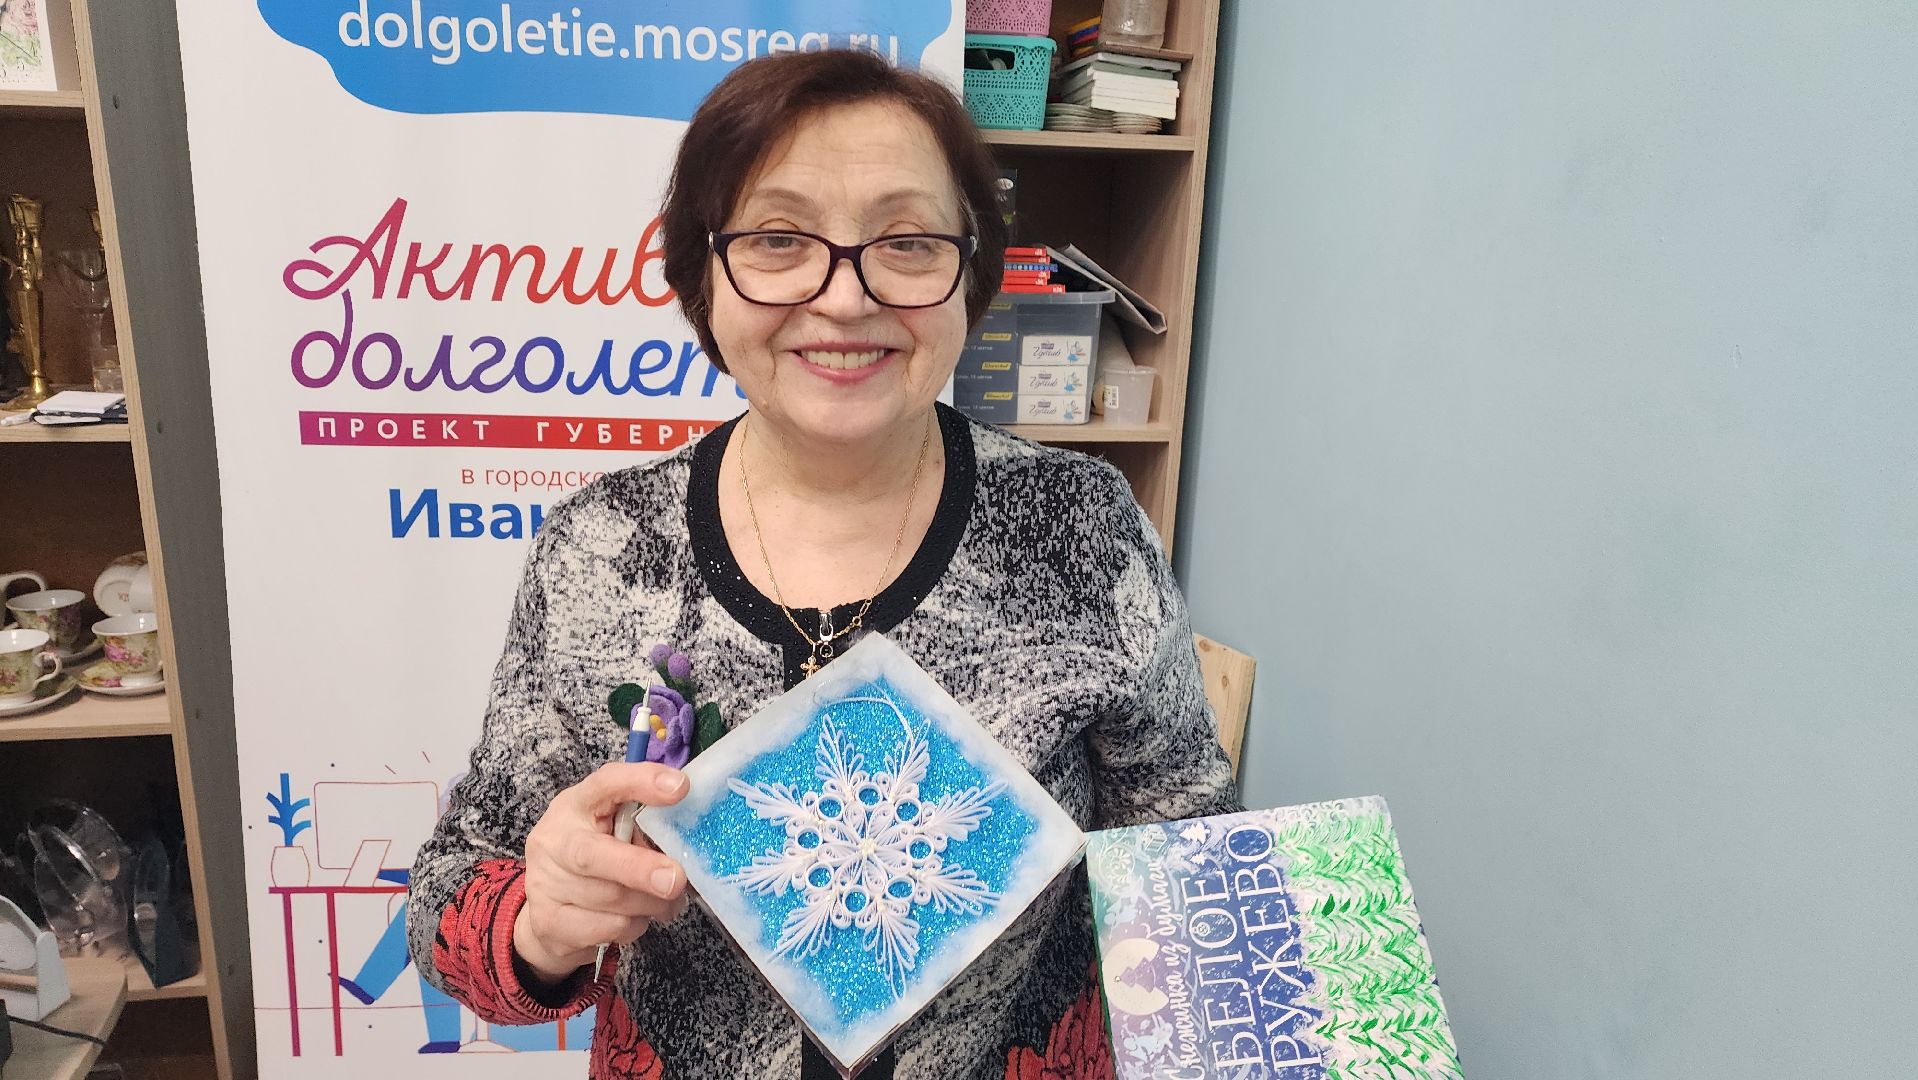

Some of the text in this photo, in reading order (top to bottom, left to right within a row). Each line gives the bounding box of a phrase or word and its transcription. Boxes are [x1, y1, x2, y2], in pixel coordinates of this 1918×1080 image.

[338, 0, 899, 67] dolgoletie.mosreru
[318, 417, 491, 441] ПРОЕКТ
[461, 469, 475, 484] в
[1140, 859, 1206, 1080] Снежинка из бумаги
[1181, 869, 1265, 1070] БЕЛОЕ
[1225, 824, 1323, 1080] РУЖЕВО
